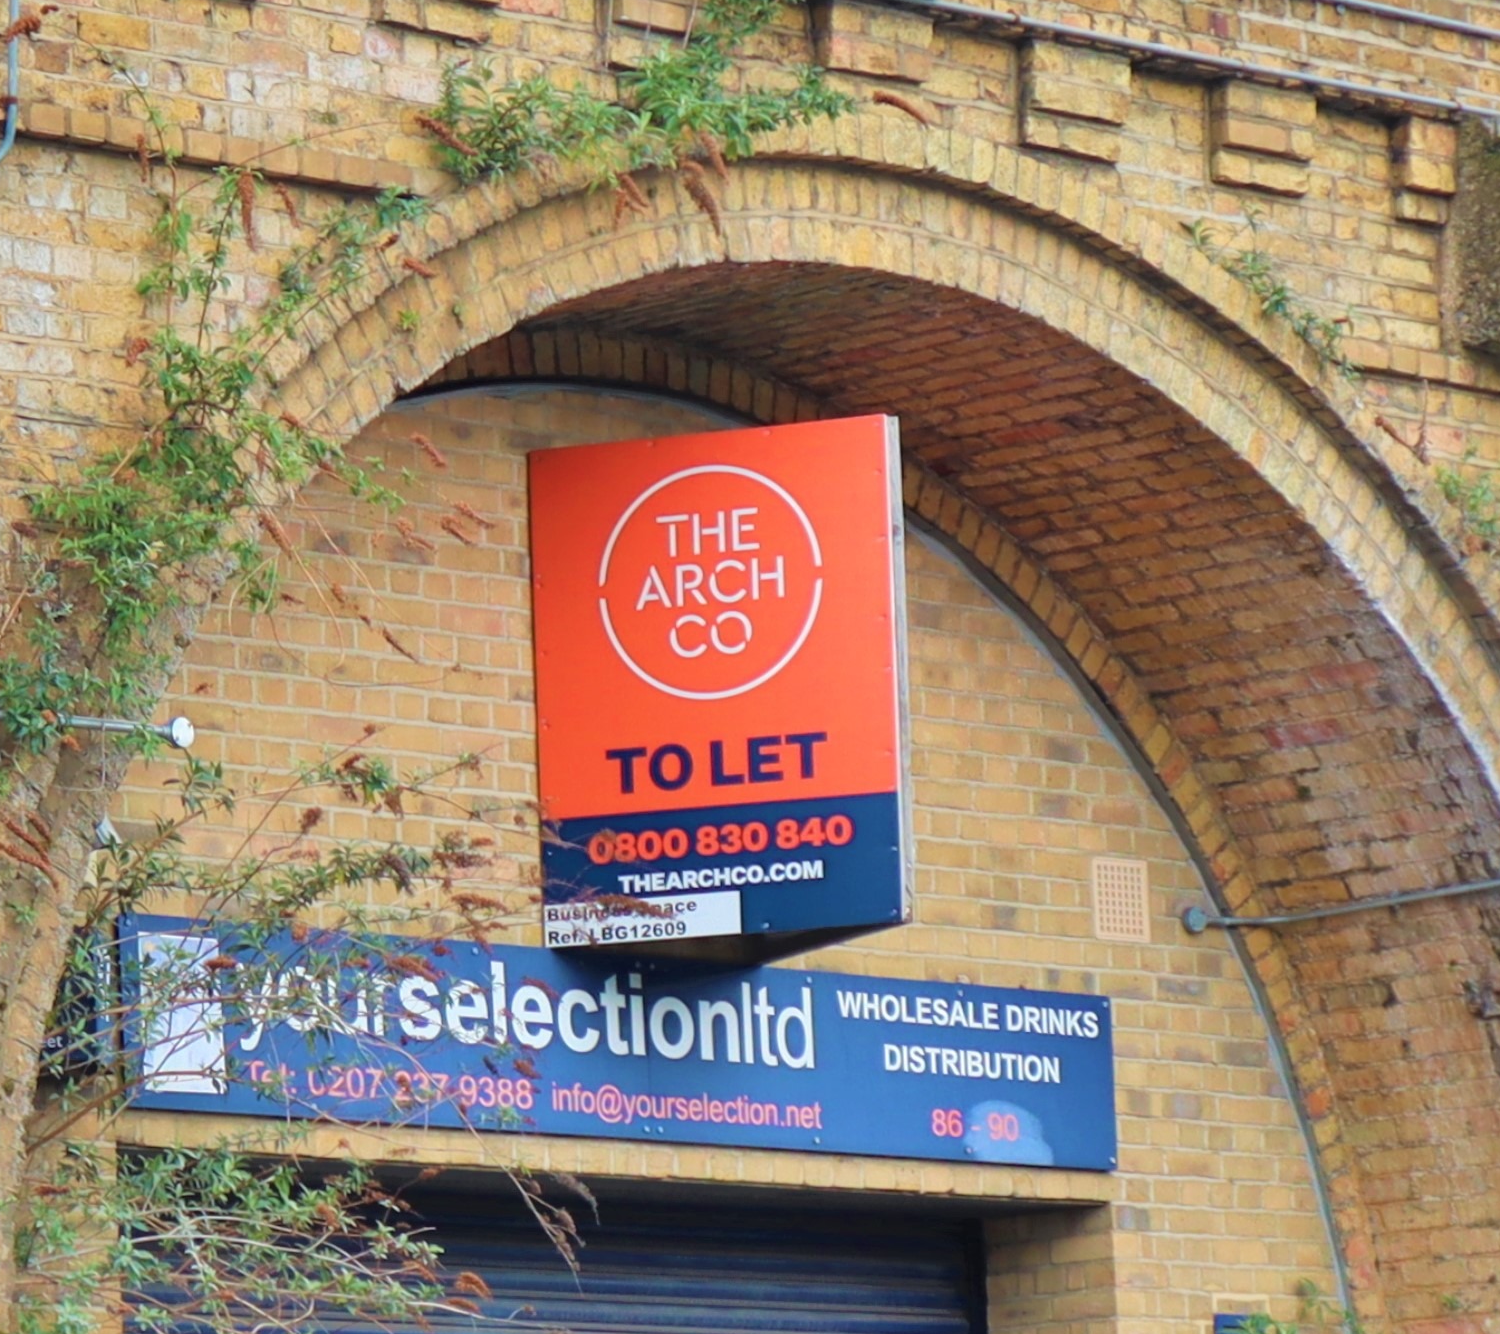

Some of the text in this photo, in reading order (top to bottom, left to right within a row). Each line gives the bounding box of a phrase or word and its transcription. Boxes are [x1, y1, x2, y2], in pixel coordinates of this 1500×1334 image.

[656, 507, 760, 558] THE
[636, 555, 785, 611] ARCH
[669, 609, 752, 658] CO
[606, 732, 827, 794] TO LET
[588, 815, 853, 865] 0800 830 840
[618, 860, 823, 895] THEARCHCO.COM
[589, 921, 687, 943] LBG12609
[635, 900, 697, 920] ace
[836, 990, 1099, 1041] WHOLESALE DRINKS
[882, 1044, 1060, 1084] DISTRIBUTION
[394, 1071, 449, 1103] 237
[459, 1075, 533, 1110] 9388
[551, 1078, 822, 1132] info@yourselection.net
[930, 1108, 963, 1137] 86
[988, 1112, 1019, 1142] 90
